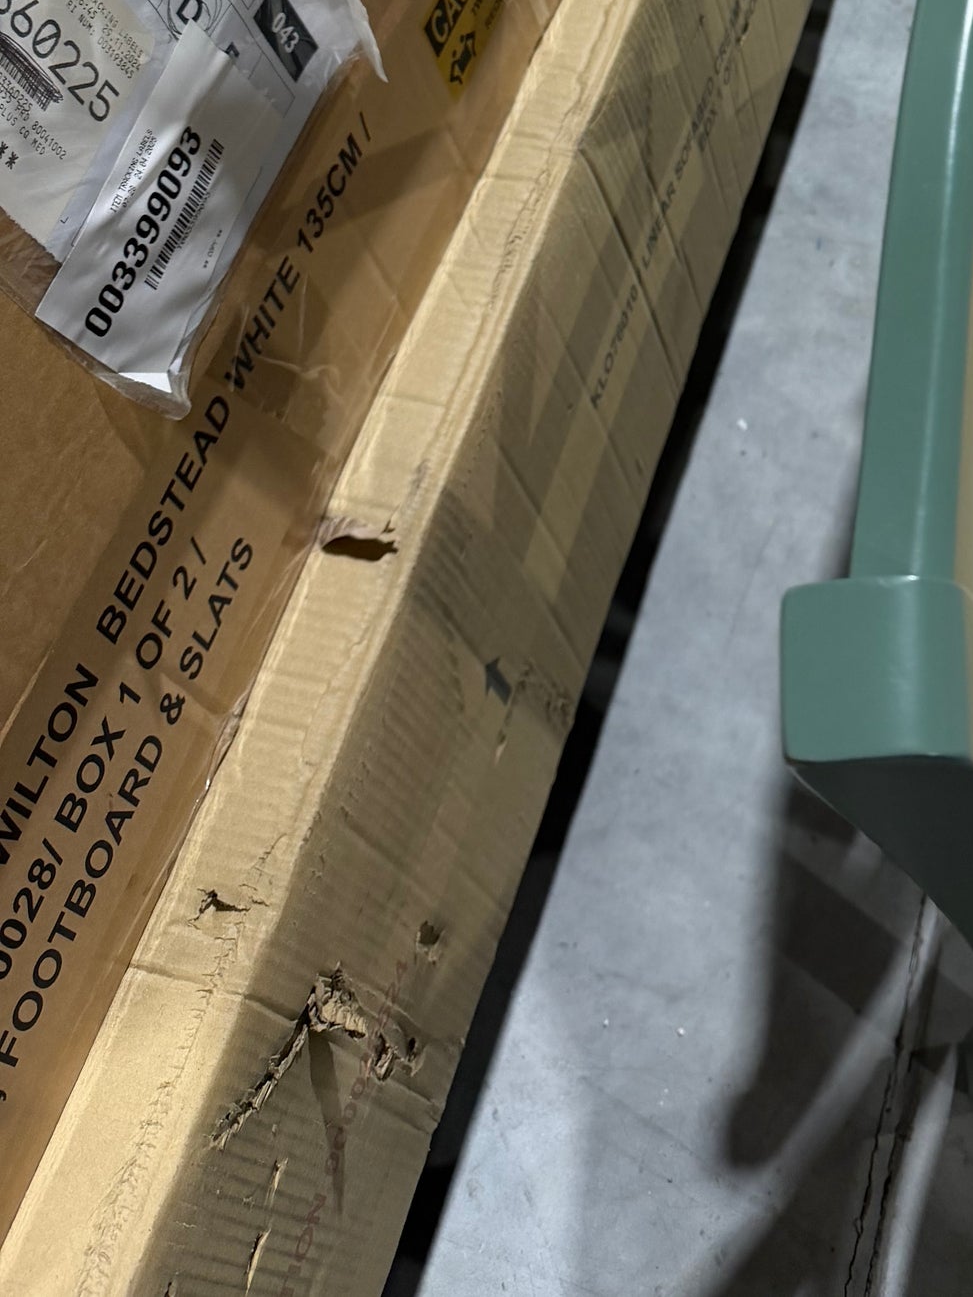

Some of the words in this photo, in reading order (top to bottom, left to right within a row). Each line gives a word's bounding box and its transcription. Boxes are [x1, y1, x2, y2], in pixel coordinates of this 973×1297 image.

[272, 12, 299, 54] 043
[85, 125, 201, 338] 003399093
[0, 662, 98, 865] WILTON
[96, 395, 231, 646] BEDSTEAD
[224, 254, 301, 391] WHITE
[297, 132, 367, 254] 135CM
[0, 733, 163, 1068] FOOTBOARD
[160, 689, 187, 725] &
[180, 537, 254, 681] SLATS
[54, 715, 126, 833] BOX
[117, 679, 143, 707] 1
[135, 599, 173, 671] OF
[172, 565, 198, 600] 2
